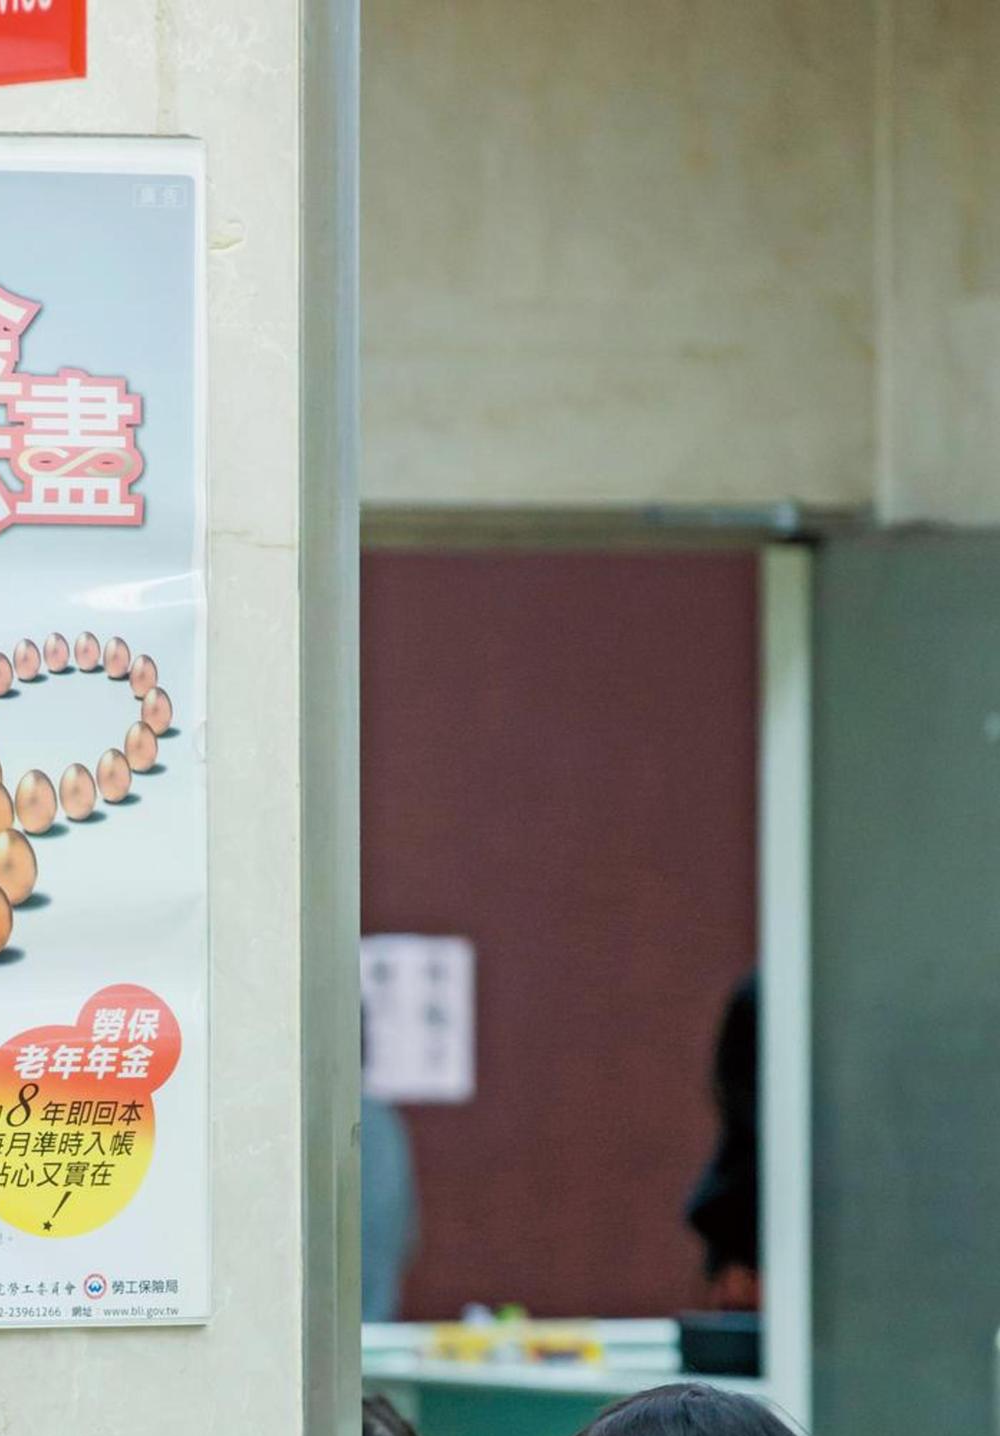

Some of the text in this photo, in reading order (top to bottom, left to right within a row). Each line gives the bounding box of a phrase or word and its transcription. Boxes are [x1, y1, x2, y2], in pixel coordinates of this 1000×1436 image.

[91, 1008, 160, 1043] 勞保
[13, 1045, 154, 1080] 老年年金
[112, 1279, 179, 1295] 勞工保險局
